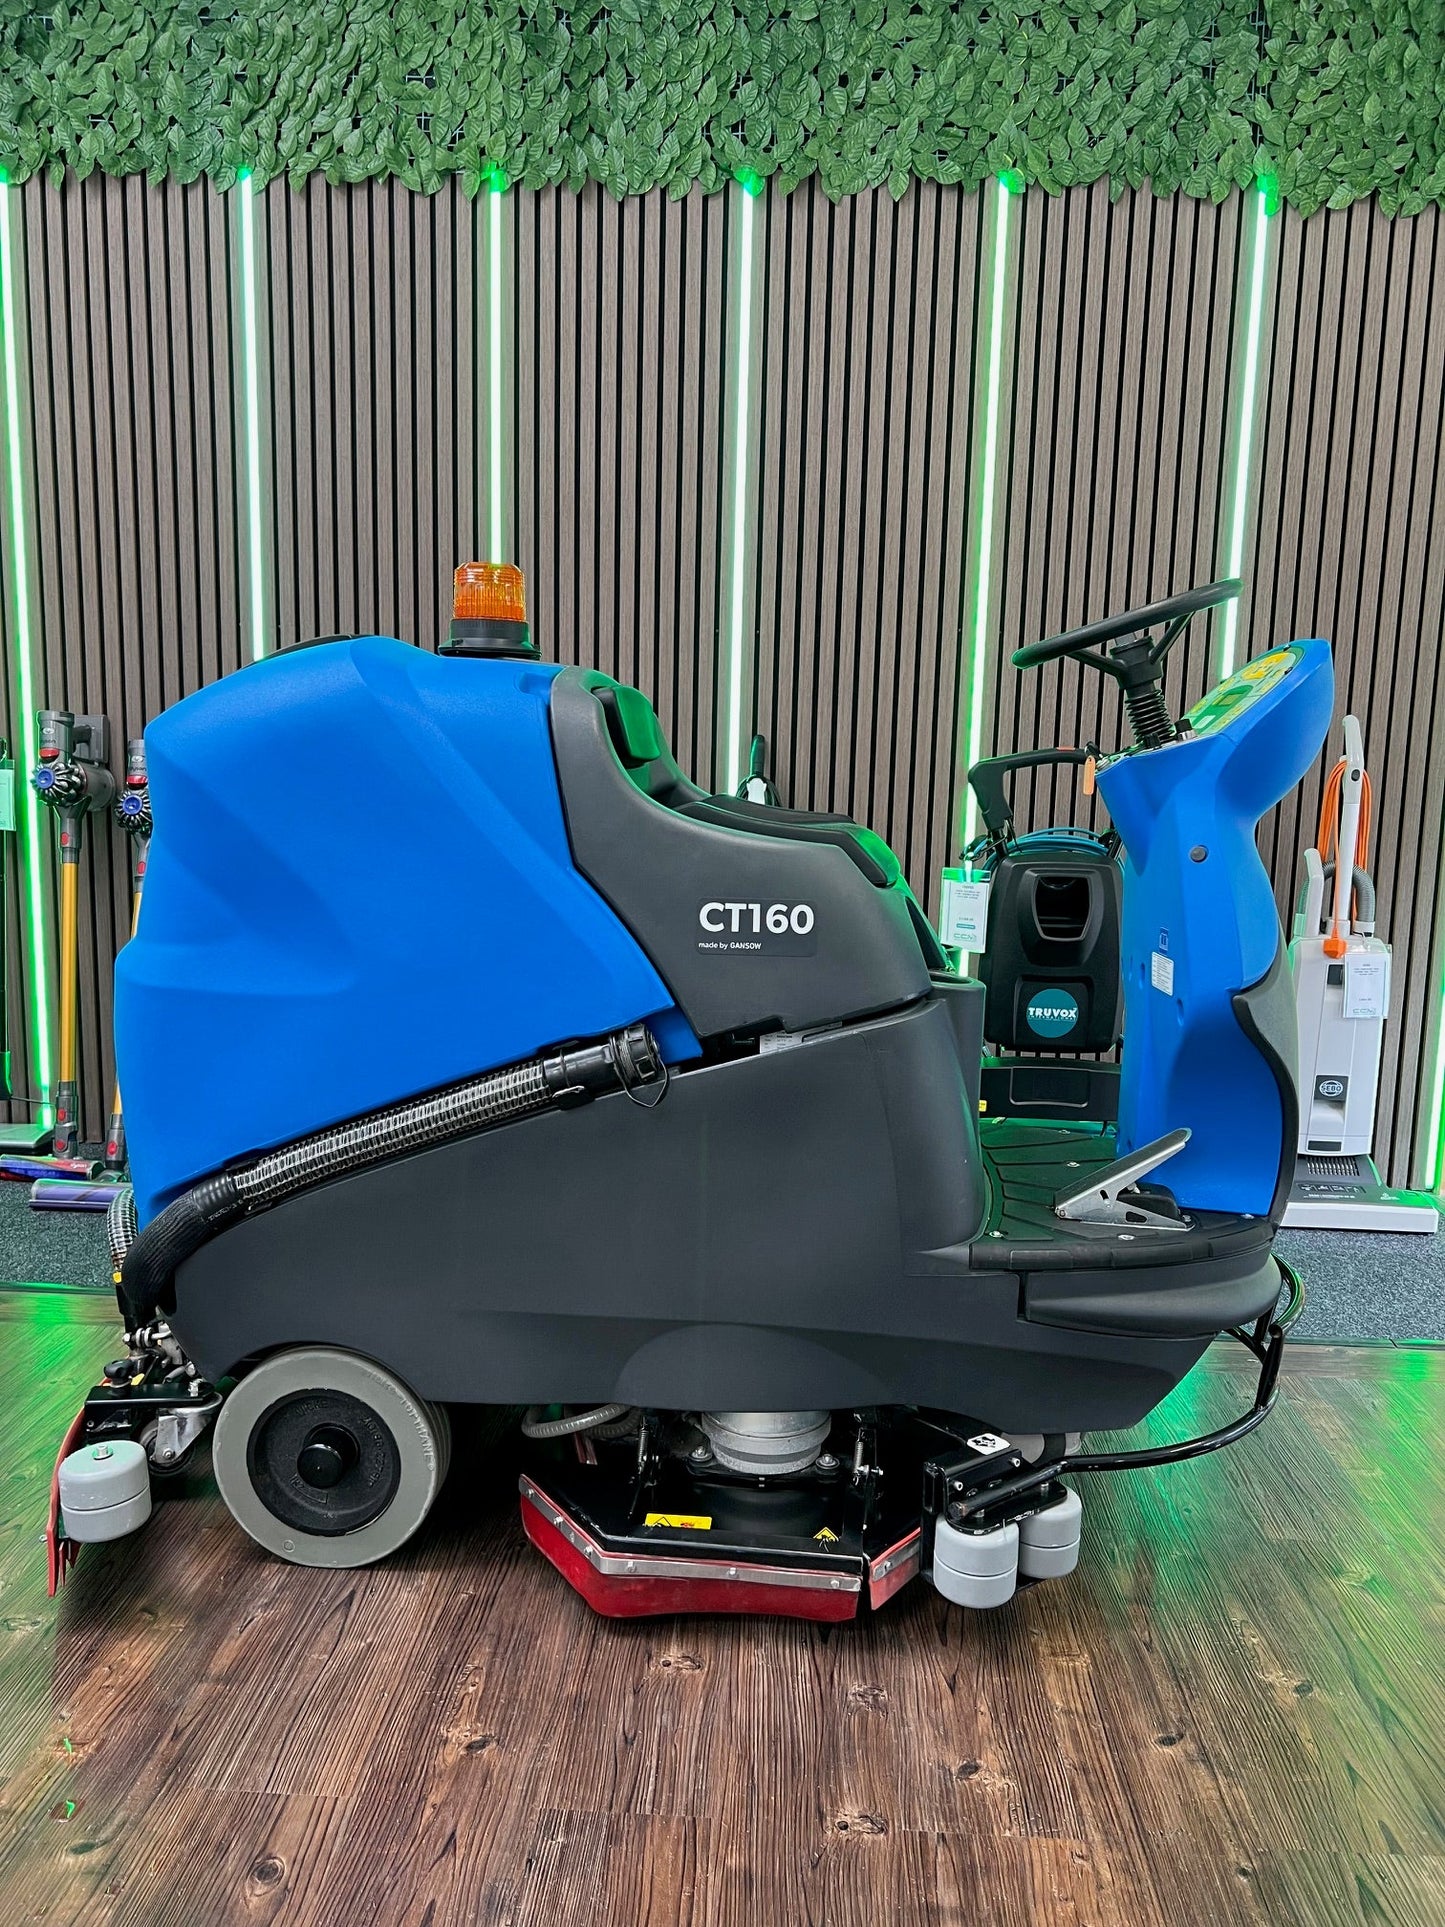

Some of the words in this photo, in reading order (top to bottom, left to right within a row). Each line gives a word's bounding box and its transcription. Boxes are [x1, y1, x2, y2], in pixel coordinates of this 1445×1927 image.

[699, 902, 815, 935] CT160
[698, 941, 718, 949] made
[719, 941, 729, 950] by
[730, 941, 762, 950] GANSOW
[1028, 1007, 1078, 1018] TRUVOX
